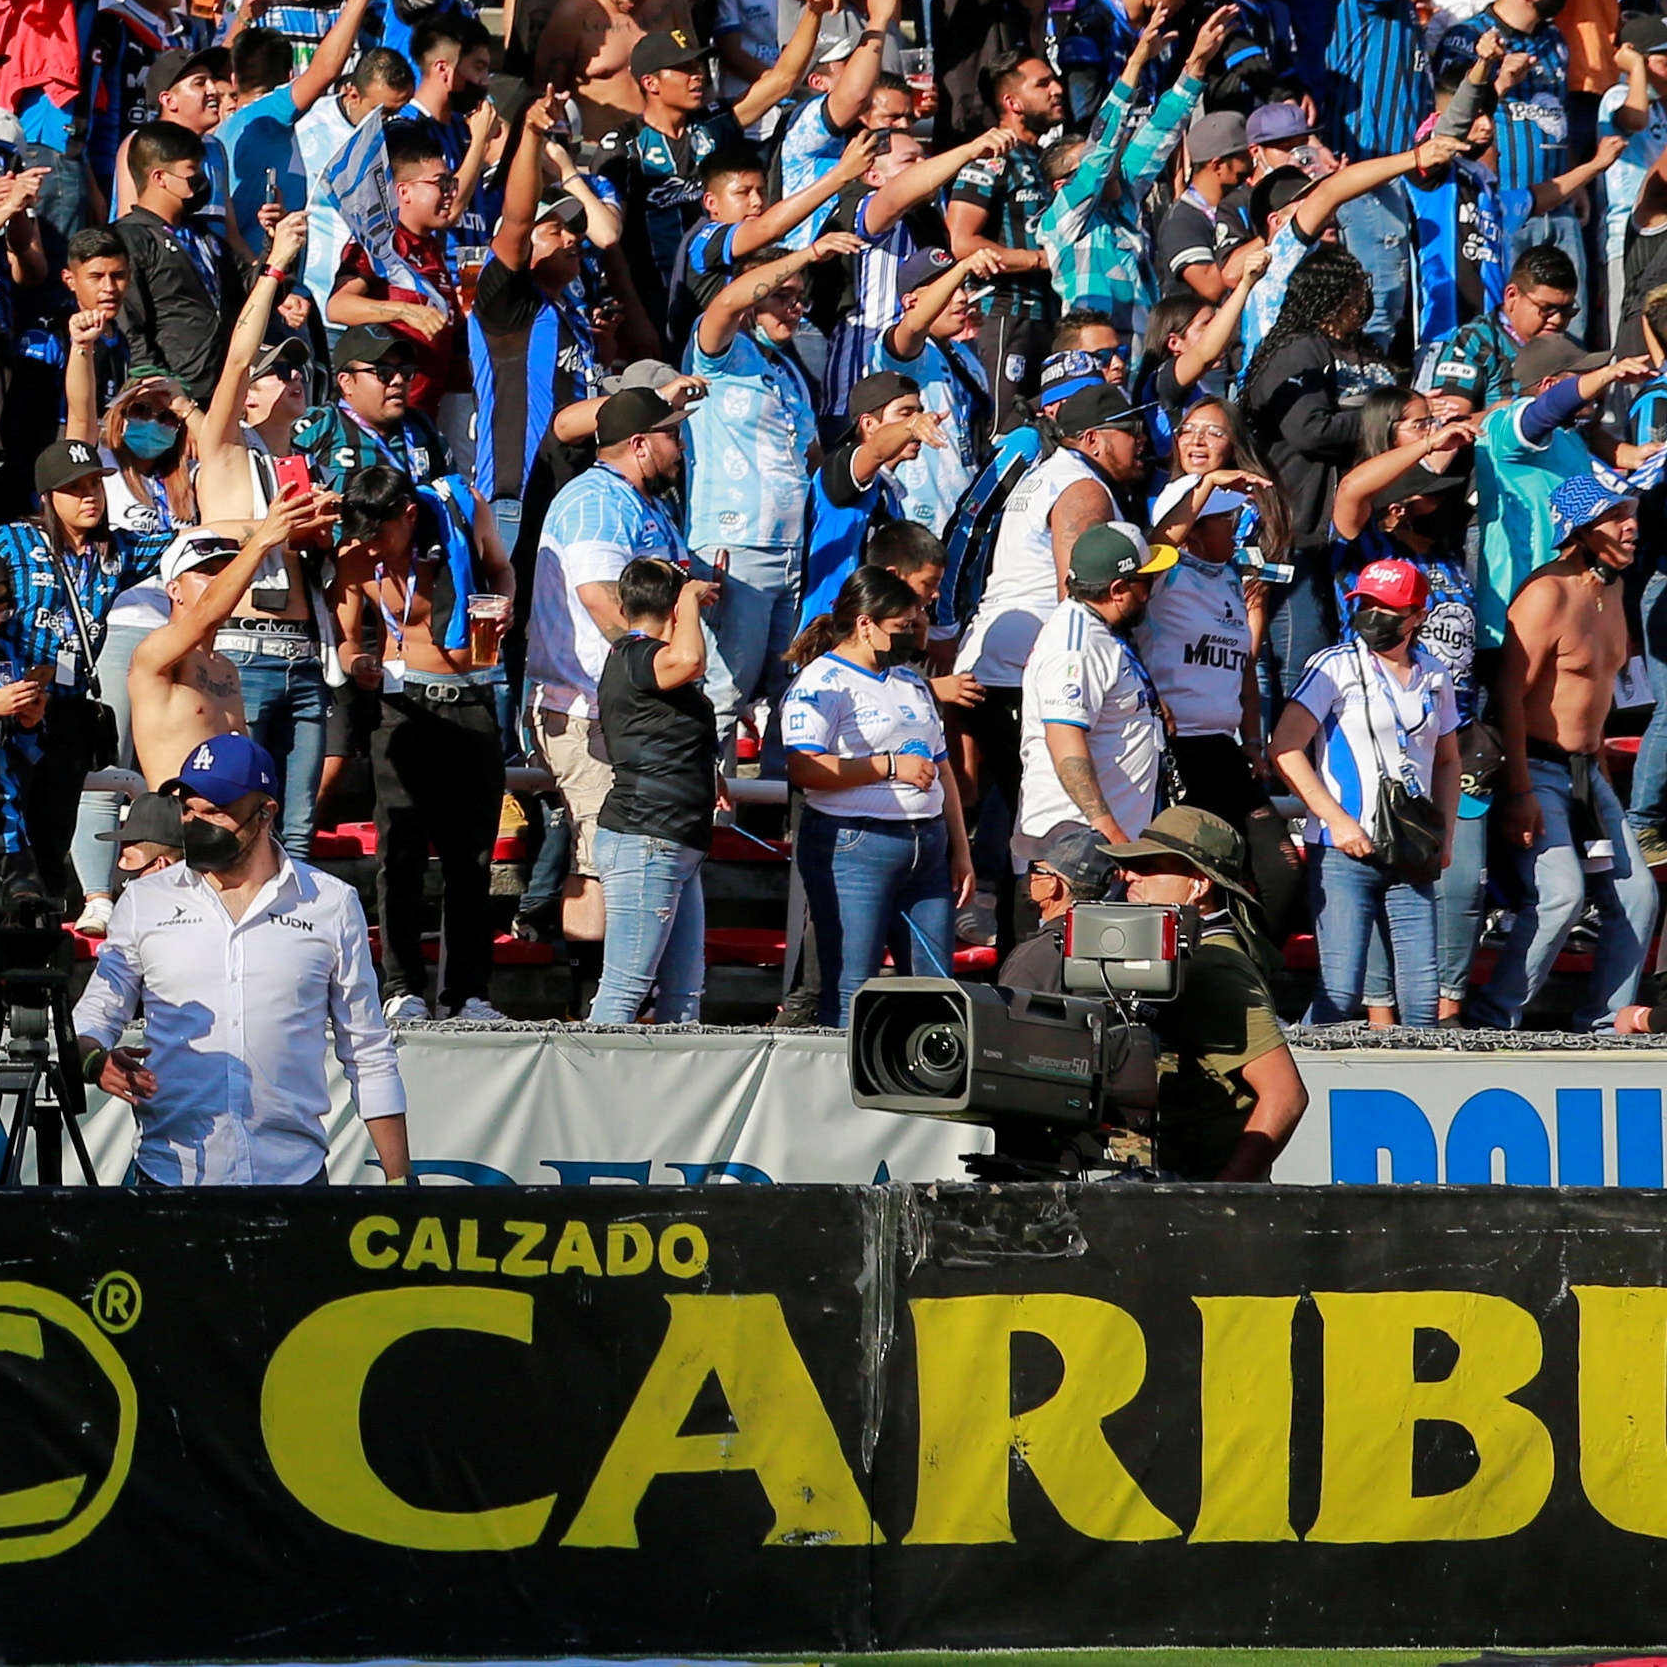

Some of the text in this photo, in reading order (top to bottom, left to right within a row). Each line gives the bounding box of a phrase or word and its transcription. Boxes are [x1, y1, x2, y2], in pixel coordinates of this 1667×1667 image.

[239, 618, 300, 637] Calvin
[1208, 636, 1239, 647] BANCO
[268, 912, 315, 933] TUDN
[348, 1215, 709, 1277] CALZADO
